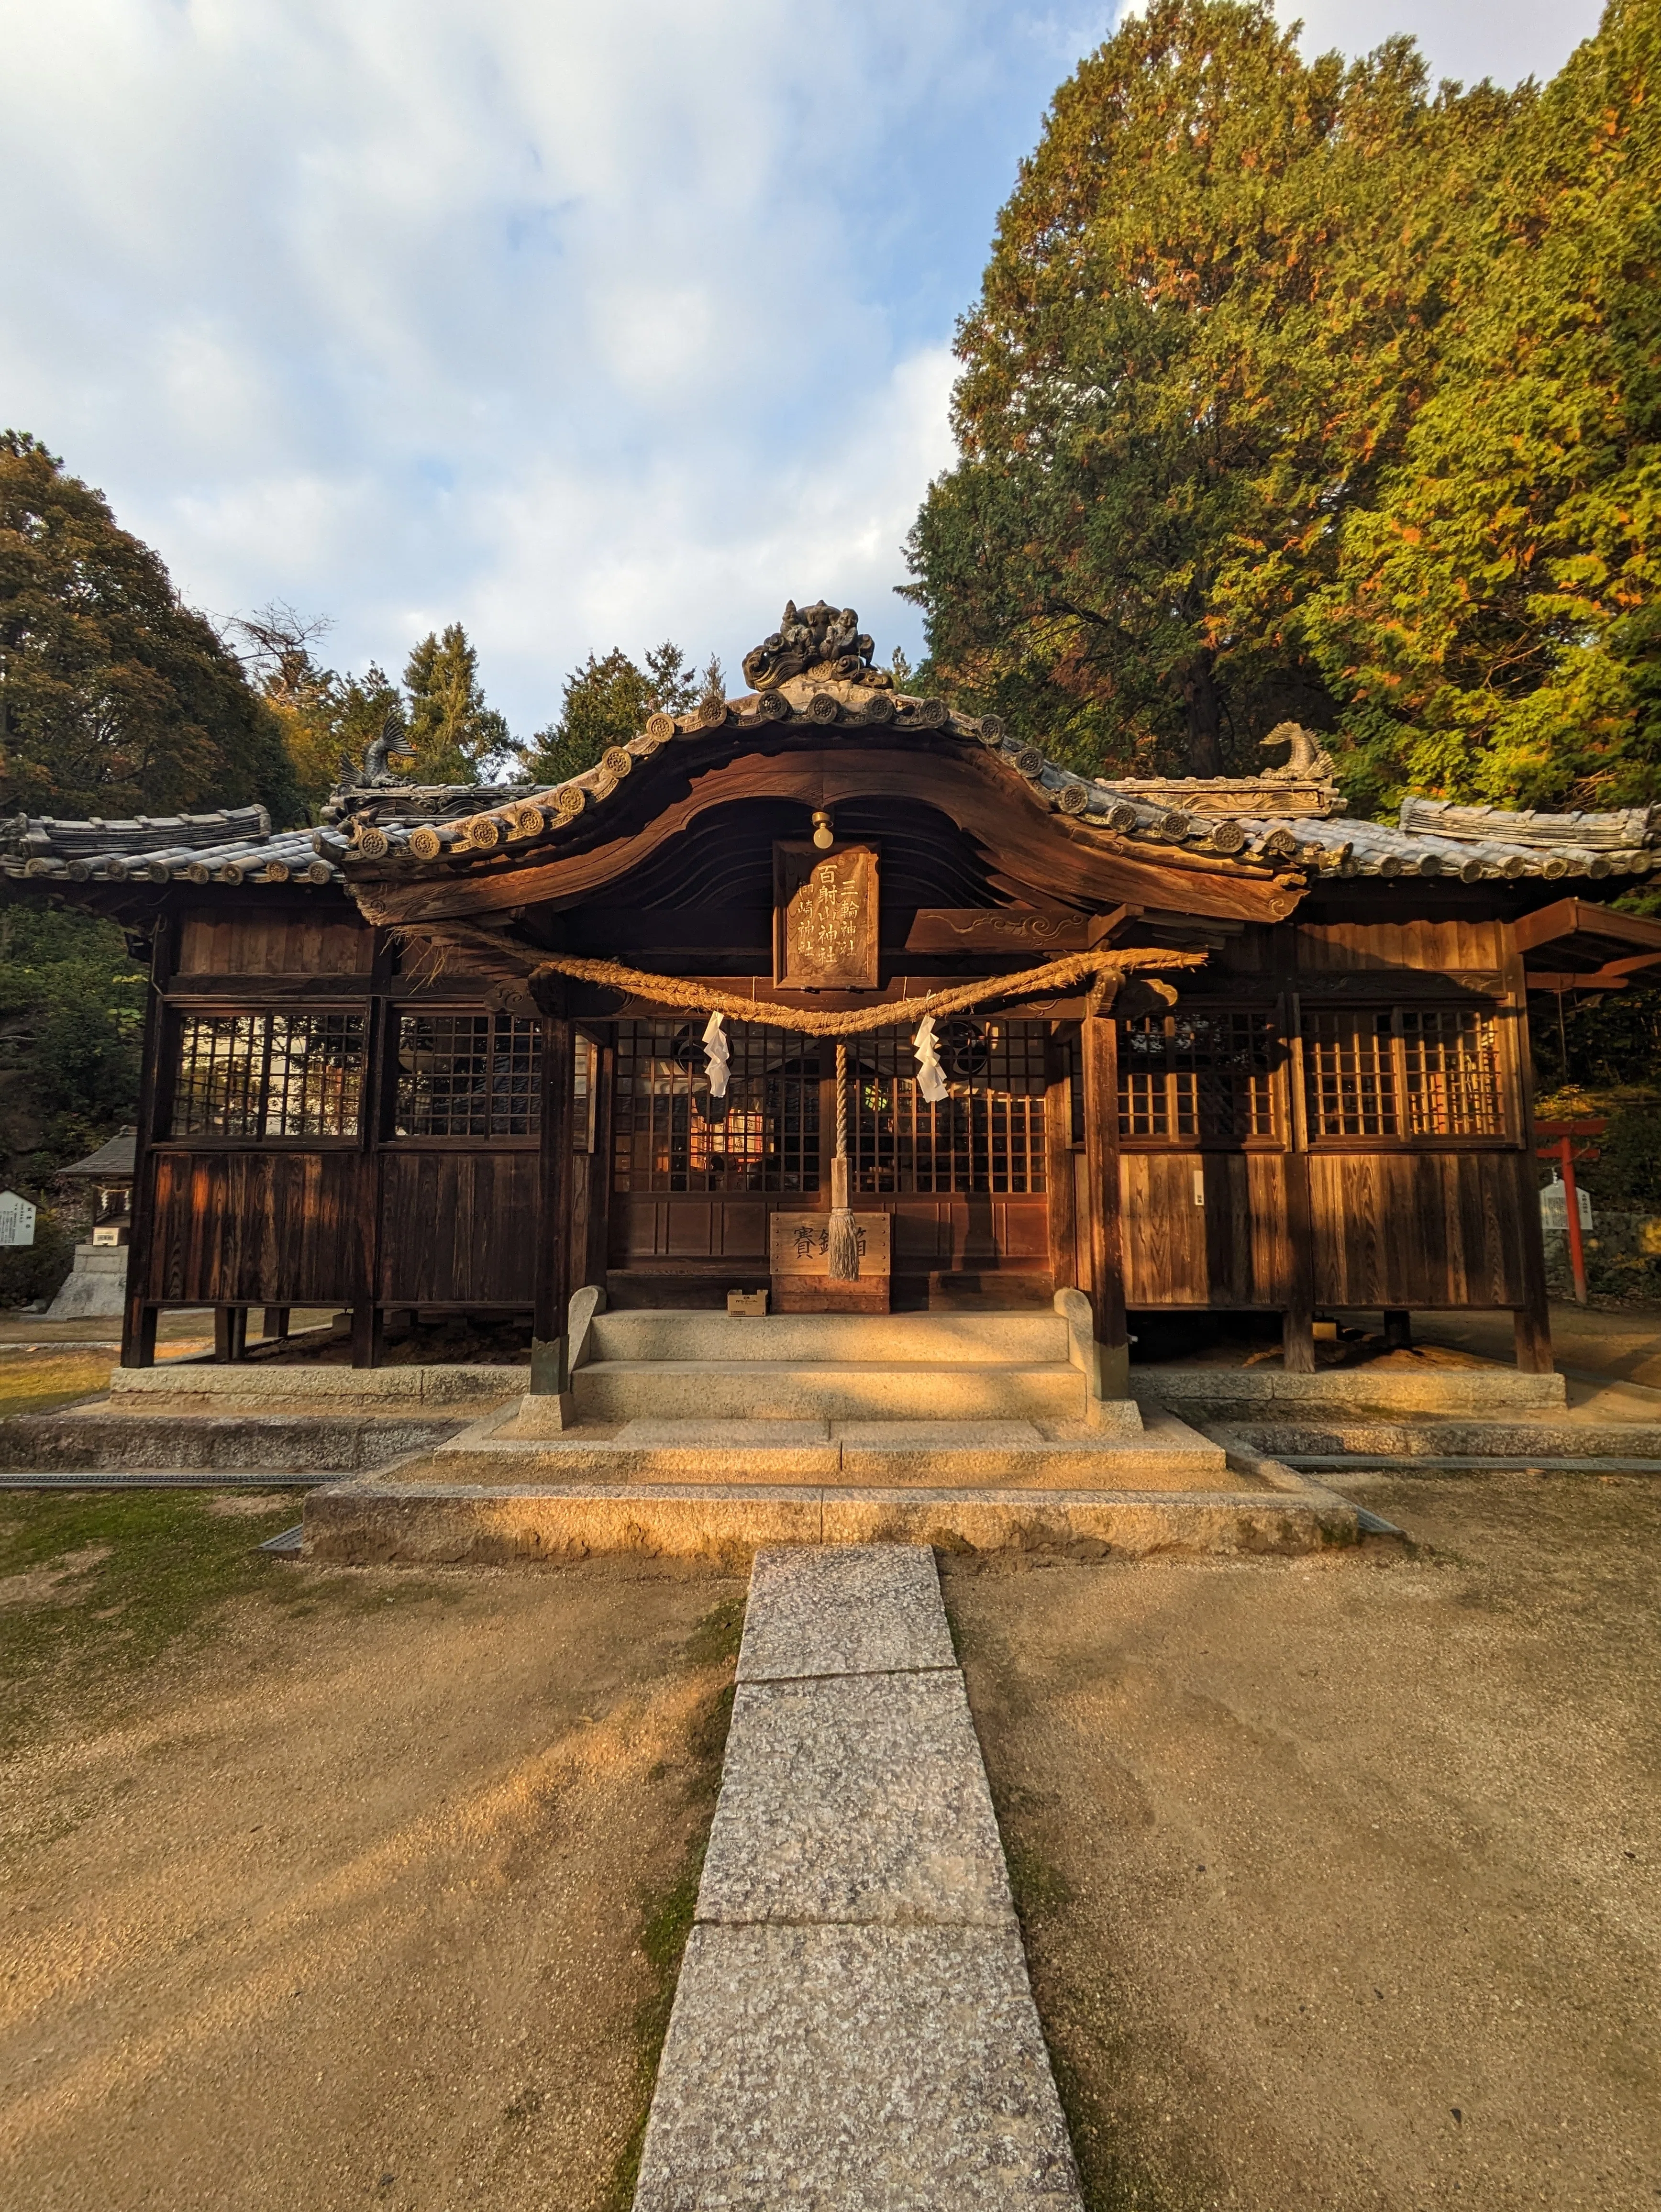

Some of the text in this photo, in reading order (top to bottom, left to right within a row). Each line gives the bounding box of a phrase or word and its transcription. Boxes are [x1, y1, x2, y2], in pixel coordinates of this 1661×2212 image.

[817, 864, 838, 964] 百射山神社
[840, 880, 860, 956] 三輪神社
